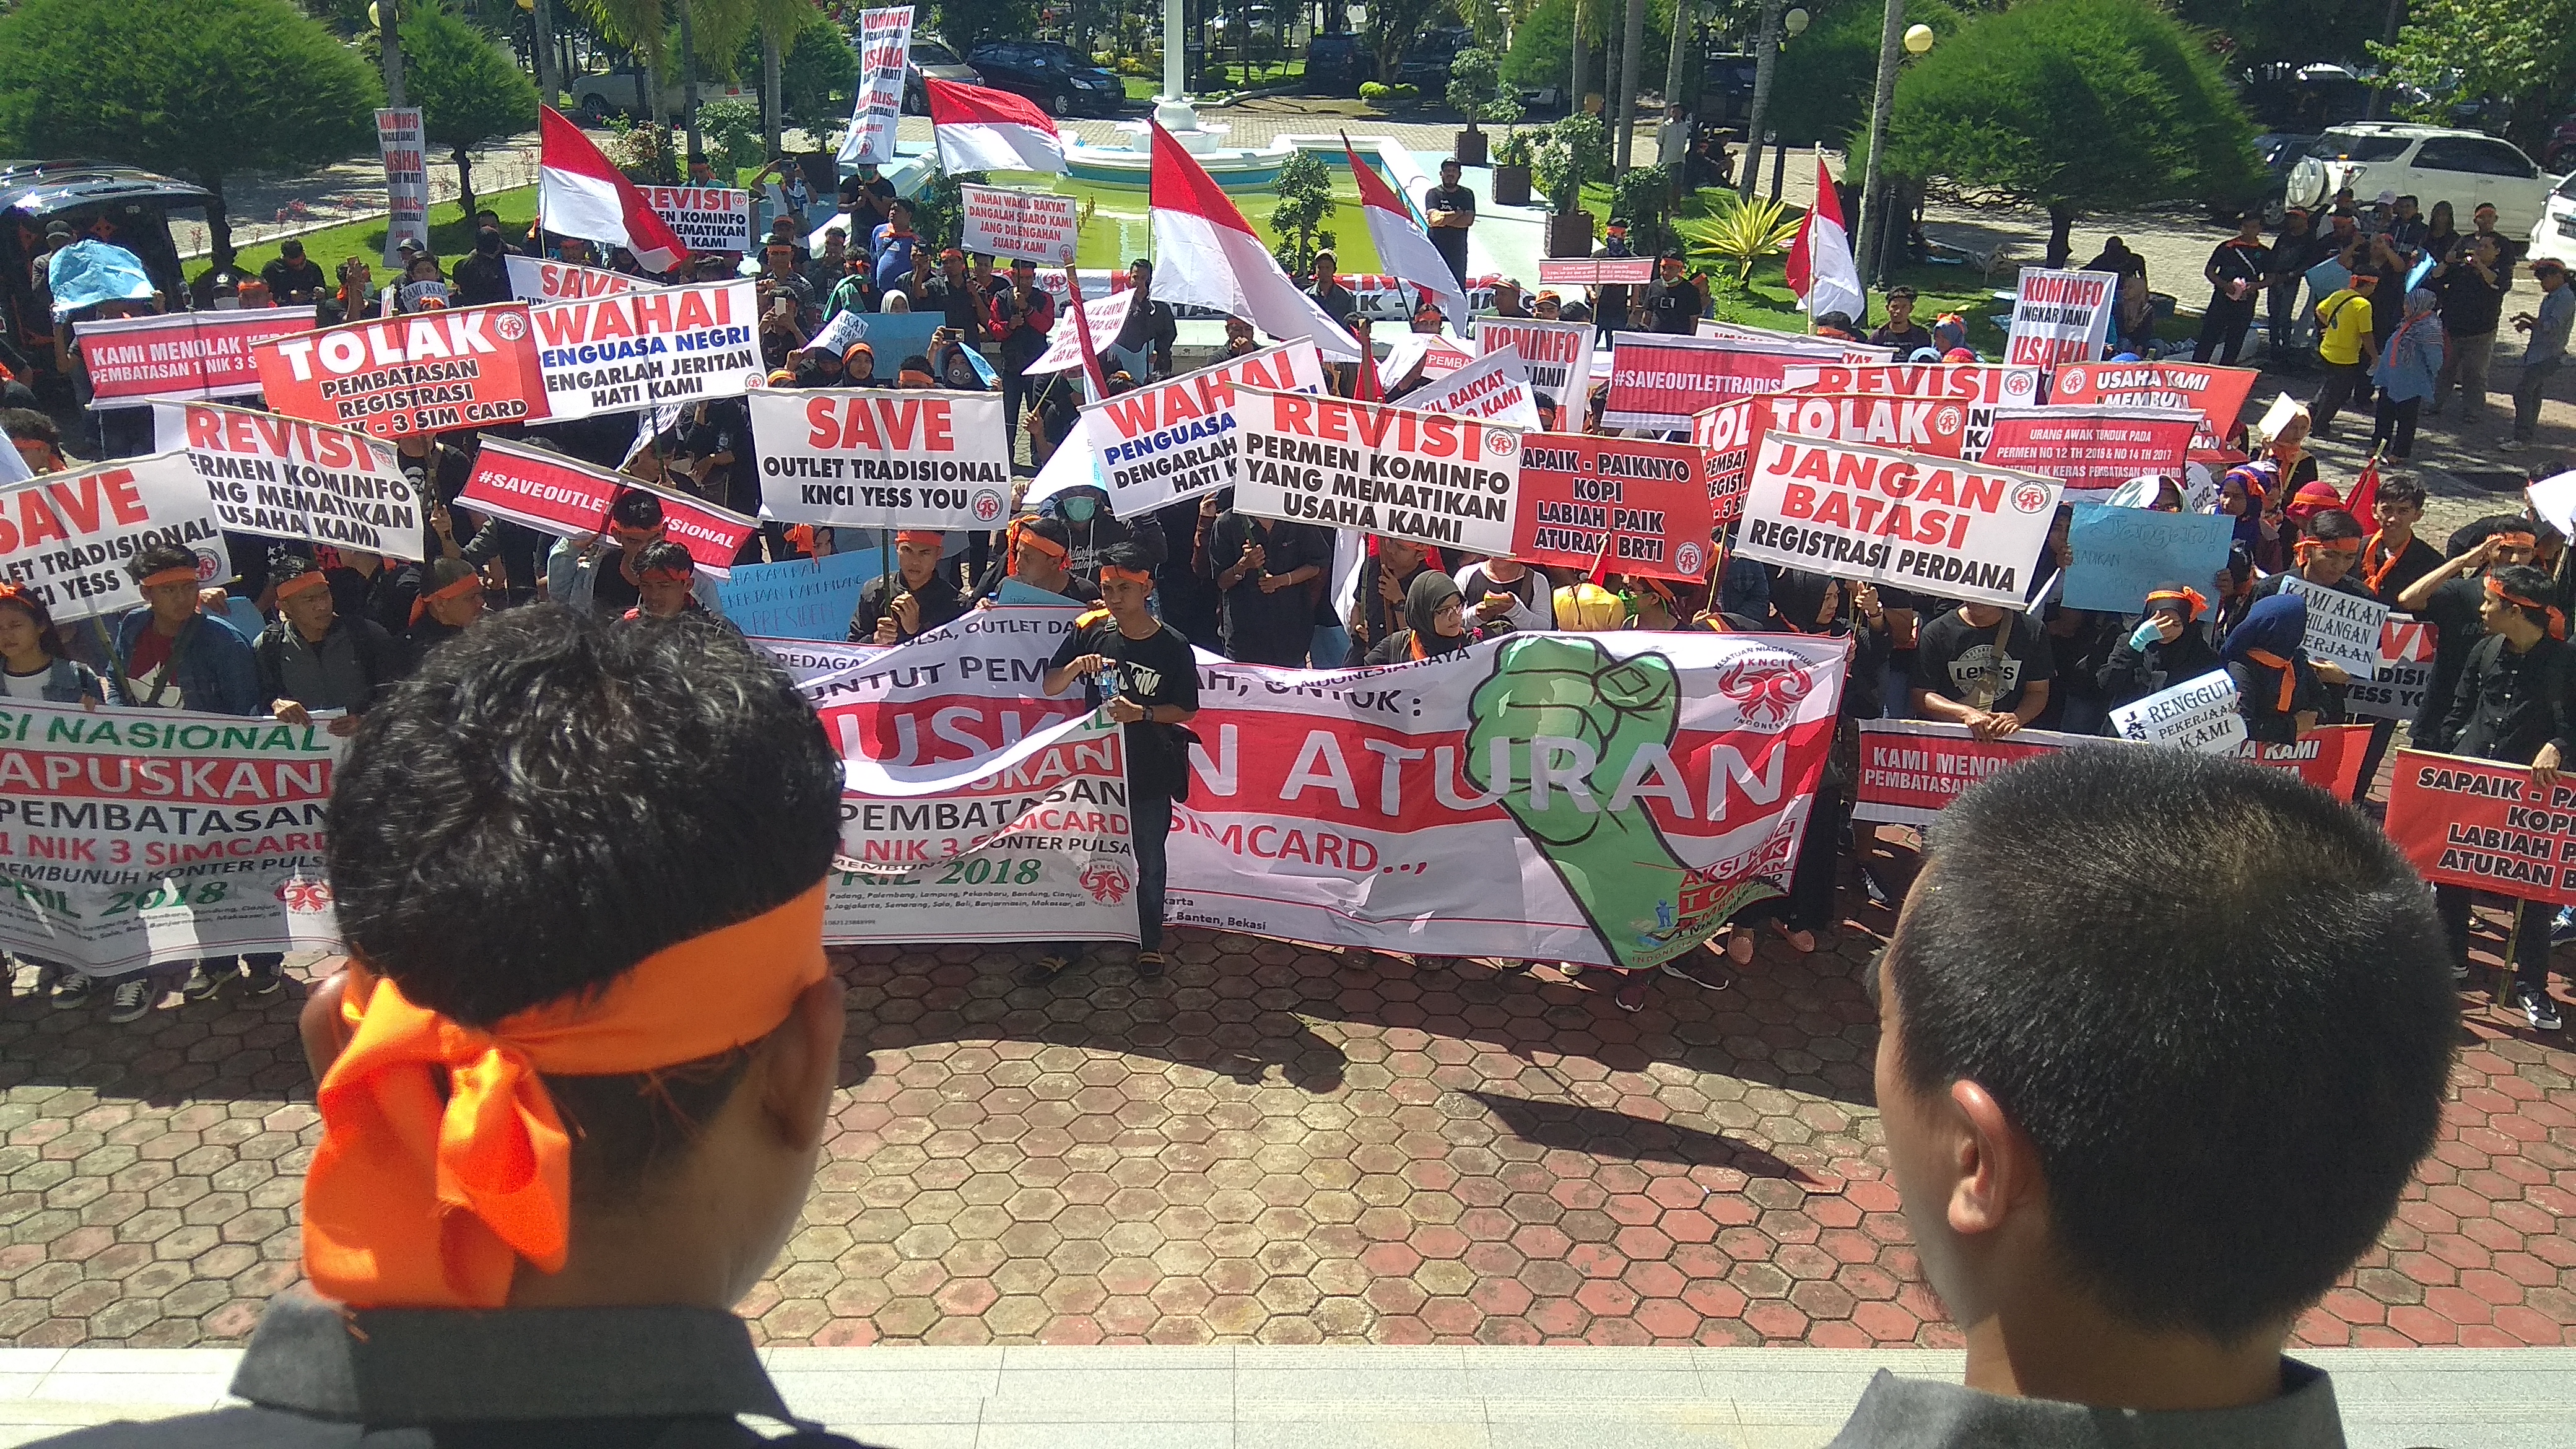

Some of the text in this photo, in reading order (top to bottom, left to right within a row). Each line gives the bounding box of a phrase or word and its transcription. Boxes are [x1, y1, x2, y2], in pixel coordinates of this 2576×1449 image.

[864, 12, 910, 30] KOMINFO
[881, 67, 901, 81] MATI
[681, 212, 746, 224] KOMINFO
[969, 206, 1072, 228] DANGALAH SUARO KAMI
[973, 193, 1066, 213] WAHAI WAKIL RAKYAT
[692, 237, 727, 247] KAMI
[980, 221, 1061, 241] JANG DILENGAHAN
[993, 237, 1046, 253] SUARO KAMI
[2023, 276, 2104, 307] KOMINFO
[536, 288, 731, 347] WAHAI
[2019, 307, 2092, 327] INGKAR JANJI
[92, 345, 145, 367] KAMI
[149, 336, 242, 359] MENOLAK
[277, 310, 497, 381] TOLAK
[542, 325, 751, 368] ENGUASA NEGRI
[1484, 326, 1579, 363] KOMINFO
[92, 362, 189, 384] PEMBATASAN
[193, 361, 202, 375] 1
[206, 359, 230, 373] NIK
[235, 357, 244, 370] 3
[320, 358, 480, 400] PEMBATASAN
[546, 349, 754, 393] ENGARLAH JERITAN
[1533, 367, 1567, 387] JANJI
[1819, 365, 2003, 404] REVISI
[2096, 370, 2211, 391] USAHA KAMI
[337, 382, 474, 420] REGISTRASI
[591, 376, 703, 408] HATI KAMI
[1104, 349, 1297, 439] WAHAI
[1448, 368, 1505, 411] RAKYAT
[1481, 386, 1523, 418] KAMI
[393, 415, 409, 432] 3
[415, 407, 460, 430] SIM
[465, 400, 528, 422] CARD
[806, 396, 954, 451] SAVE
[1273, 391, 1481, 463] REVISI
[1772, 397, 1933, 445] TOLAK
[185, 406, 376, 472] REVISI
[1104, 412, 1237, 466] PENGUASA
[2030, 429, 2151, 442] URANG AWAK TUNDUK PADA
[1113, 436, 1237, 489] DENGARLAH
[1247, 433, 1360, 473] PERMEN
[1370, 453, 1510, 495] KOMINFO
[1598, 453, 1690, 483] PAIKNYO
[1997, 446, 2037, 459] PERMEN
[2039, 448, 2053, 458] NO
[2056, 448, 2068, 458] 12
[2071, 448, 2082, 459] TH
[2107, 450, 2112, 459] &
[2114, 448, 2126, 460] NO
[2129, 448, 2139, 460] 14
[2141, 449, 2151, 460] TH
[2153, 449, 2172, 460] 2017
[282, 463, 411, 502] KOMINFO
[763, 456, 1007, 483] OUTLET TRADISIONAL
[1172, 466, 1220, 494] HATI
[1766, 444, 2007, 514] JANGAN
[2053, 466, 2086, 477] KERAS
[206, 479, 414, 529] NG MEMATIKAN
[801, 484, 967, 510] KNCI YESS YOU
[1245, 458, 1323, 492] YANG
[1332, 474, 1507, 523] MEMATIKAN
[1573, 478, 1622, 504] KOPI
[216, 505, 381, 549] USAHA KAMI
[1284, 492, 1463, 544] USAHA KAMI
[1538, 501, 1665, 534] LABIAH PAIK
[1780, 483, 1970, 549] BATASI
[40, 517, 219, 575] TRADISIONAL
[1533, 528, 1665, 562] ATURAN BRTI
[1749, 518, 2016, 593] REGISTRASI PERDANA
[59, 569, 120, 601] YESS
[965, 619, 1043, 635] OUTLET
[2307, 612, 2371, 645] HILANGAN
[2331, 598, 2387, 629] AKAN
[1748, 658, 1785, 666] KNCI
[2303, 635, 2374, 664] ERJAAN
[2147, 679, 2232, 724] RENGGUT
[46, 716, 330, 752] NASIONAL
[2159, 700, 2235, 740] PEKERJAAN
[2179, 720, 2232, 751] KAMI
[1873, 747, 1928, 772] KAMI
[2264, 740, 2321, 760] KAMI
[0, 752, 322, 800] APUSKAN
[1279, 728, 1787, 822] ATURAN
[2417, 765, 2525, 802] SAPAIK
[28, 835, 97, 863] NIK
[110, 843, 131, 864] 3
[866, 838, 929, 862] NIK
[942, 837, 958, 859] 3
[1068, 835, 1131, 856] PULSA
[2447, 823, 2554, 861] LABIAH
[146, 855, 323, 882] KONTER PULS
[935, 858, 1043, 886] 2018
[1681, 856, 1739, 888] AKSI
[2438, 848, 2554, 888] ATURAN
[829, 892, 864, 900] Padang,
[867, 892, 918, 900] Palembang,
[1011, 890, 1050, 899] Bandung,
[885, 901, 930, 909] Semarang,
[1176, 912, 1266, 931] Banten, Bekasi
